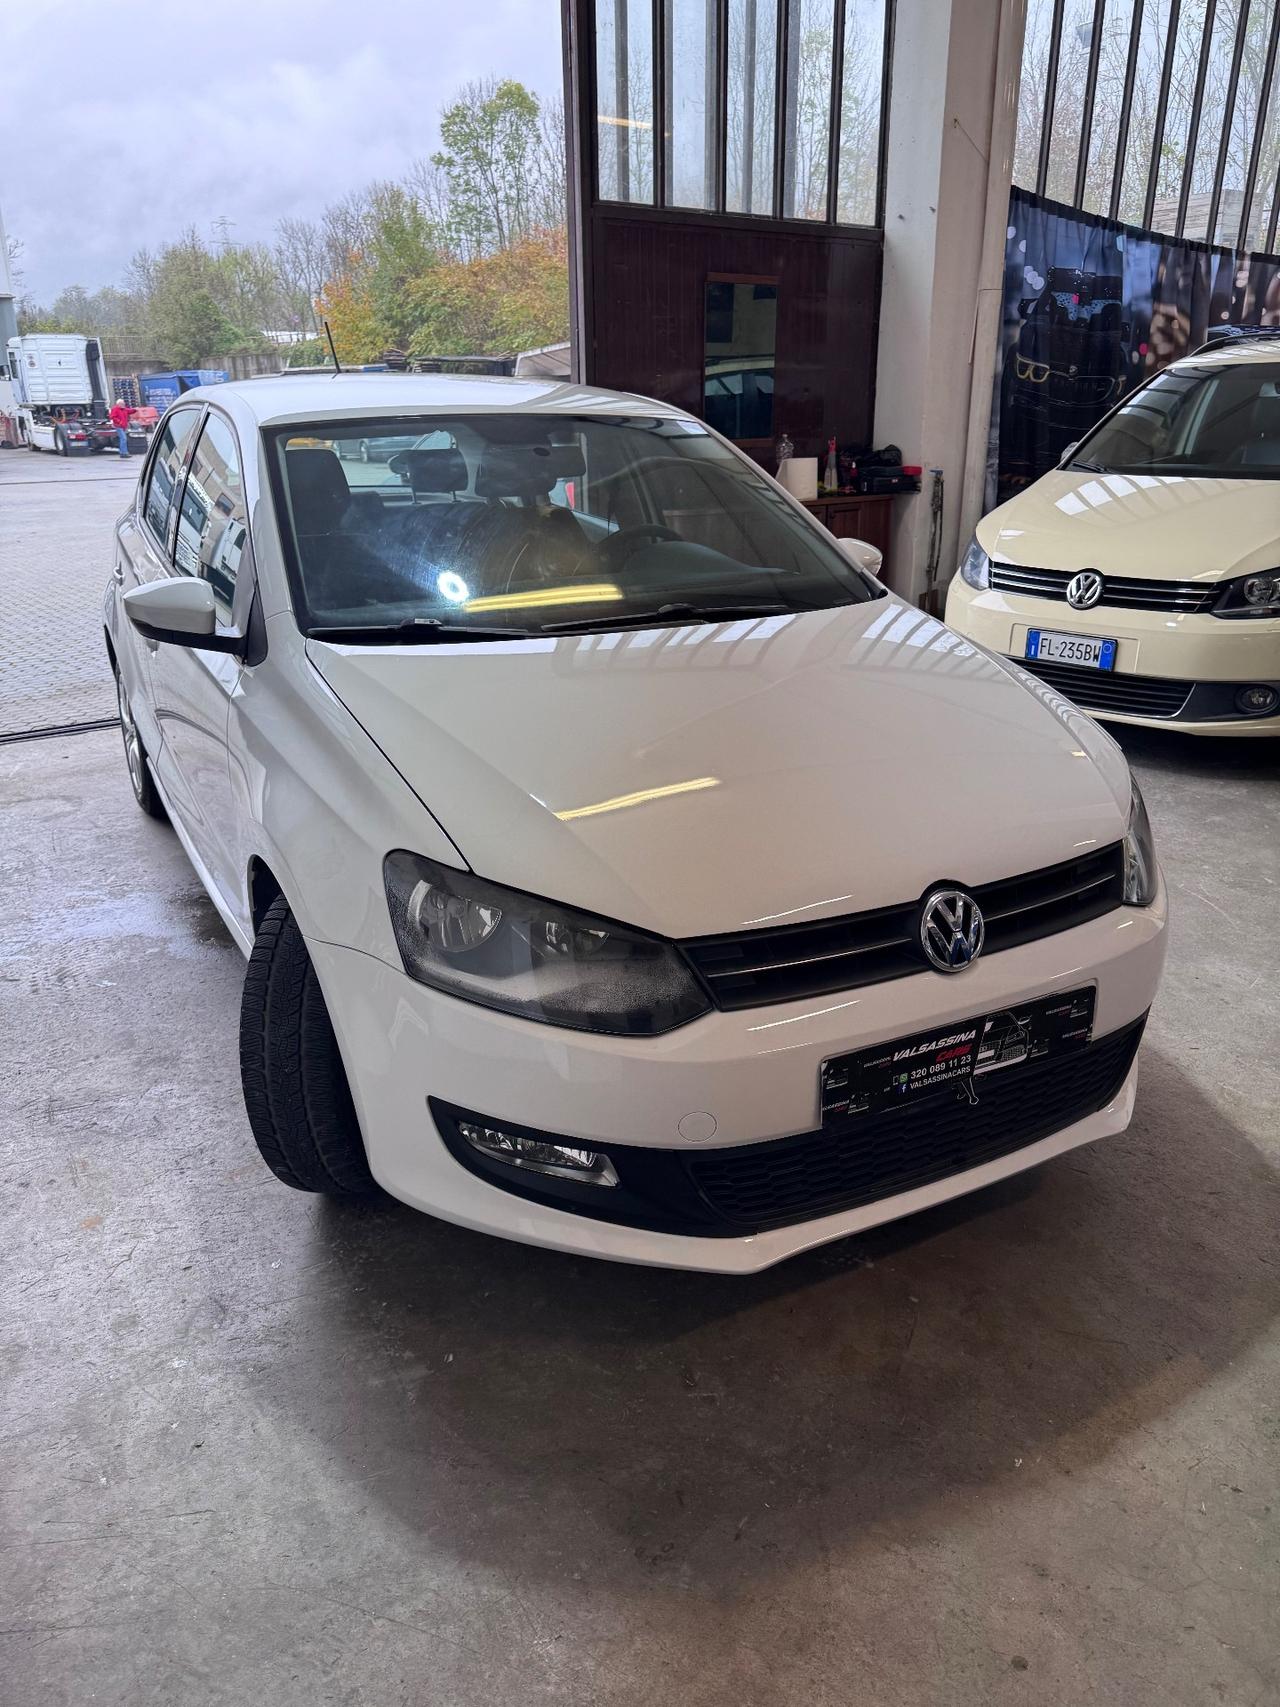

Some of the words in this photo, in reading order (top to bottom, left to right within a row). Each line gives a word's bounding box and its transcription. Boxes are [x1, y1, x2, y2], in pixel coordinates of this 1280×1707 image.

[893, 1030, 976, 1061] VALSASSINA
[910, 1067, 927, 1079] 320
[929, 1062, 946, 1073] 089
[948, 1058, 958, 1068] 11
[960, 1054, 972, 1065] 23
[910, 1065, 971, 1089] VALSASSINACARS
